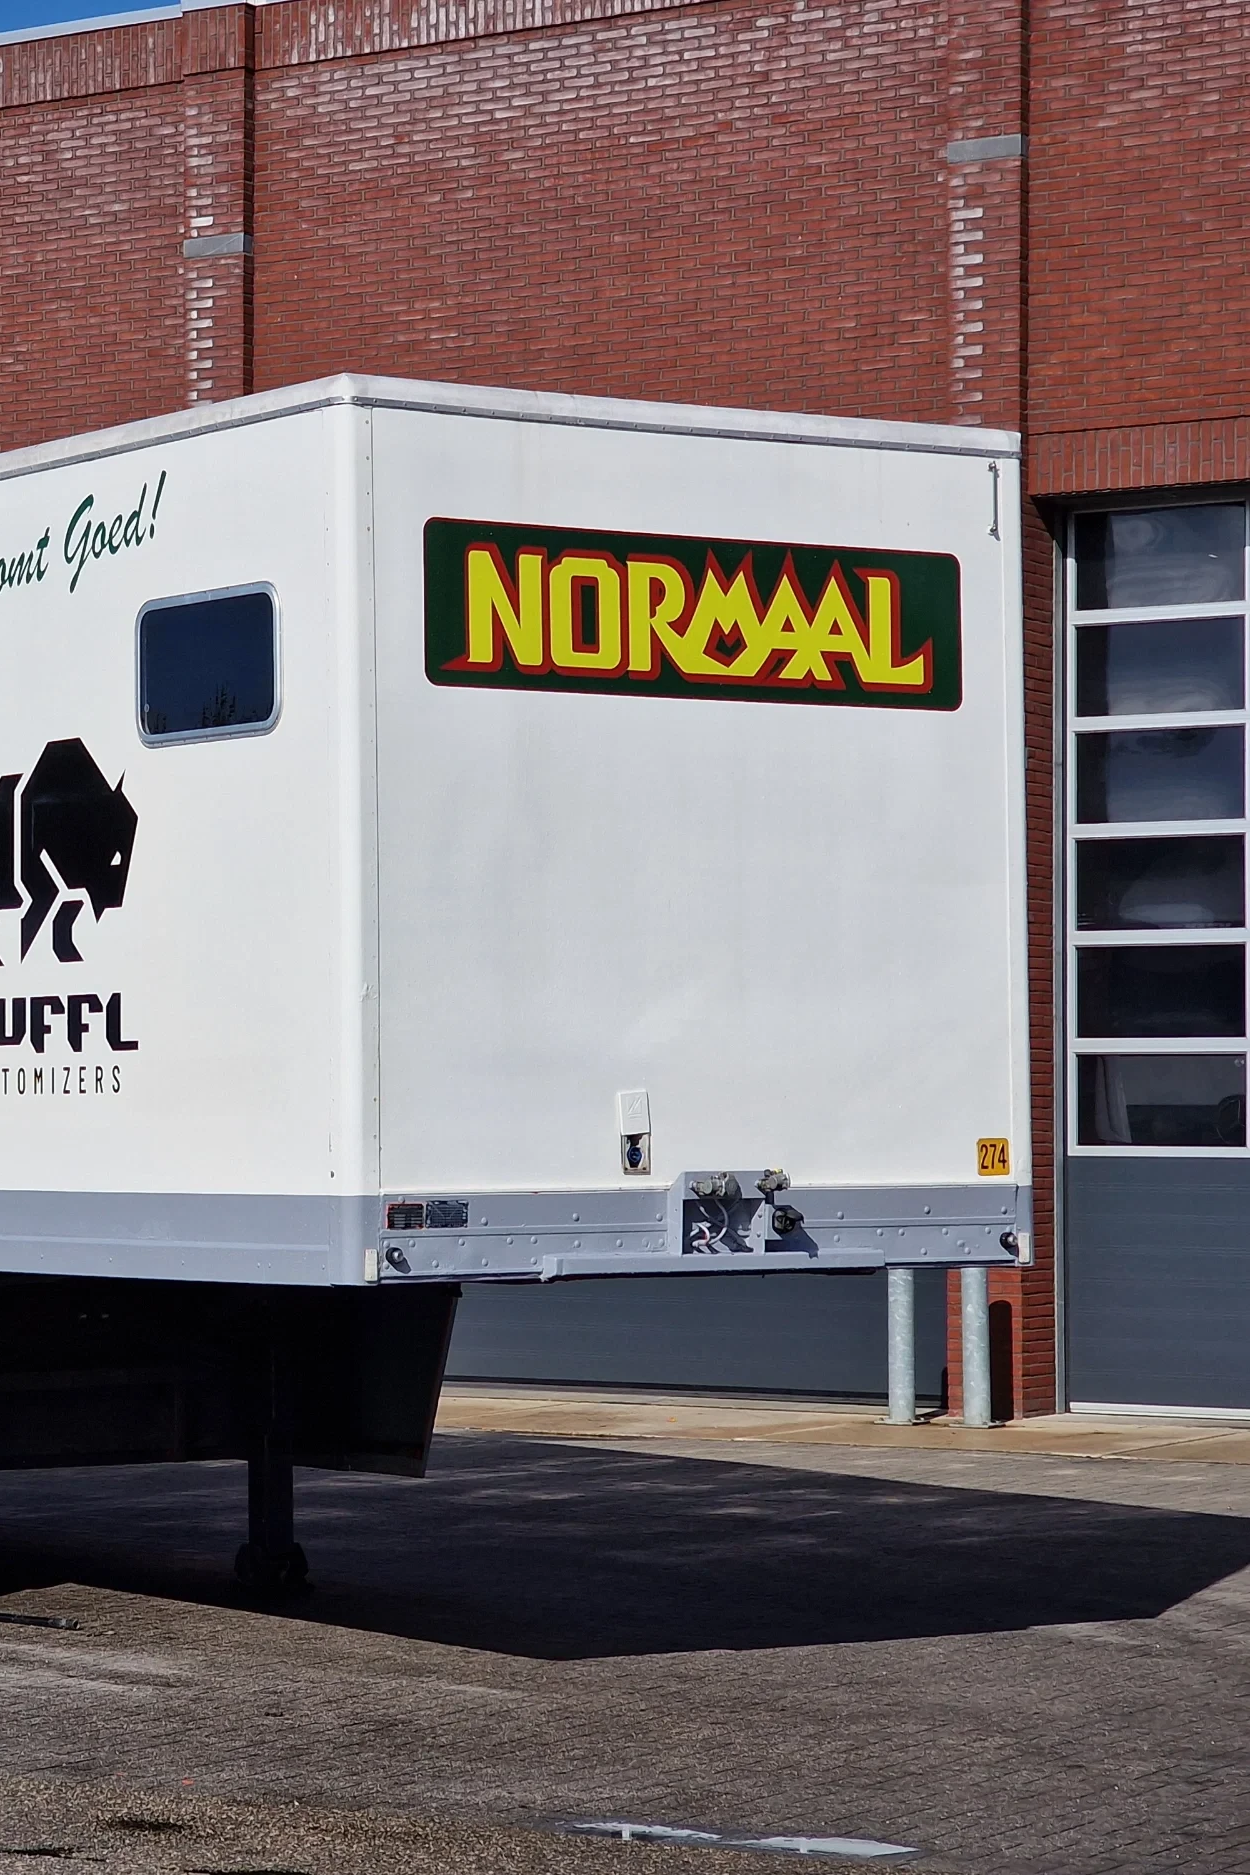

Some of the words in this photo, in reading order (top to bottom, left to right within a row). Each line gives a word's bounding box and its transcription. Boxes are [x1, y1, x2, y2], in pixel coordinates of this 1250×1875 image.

[63, 469, 167, 594] Goed!
[450, 545, 931, 691] NORMAAL
[980, 1143, 1008, 1170] 274
